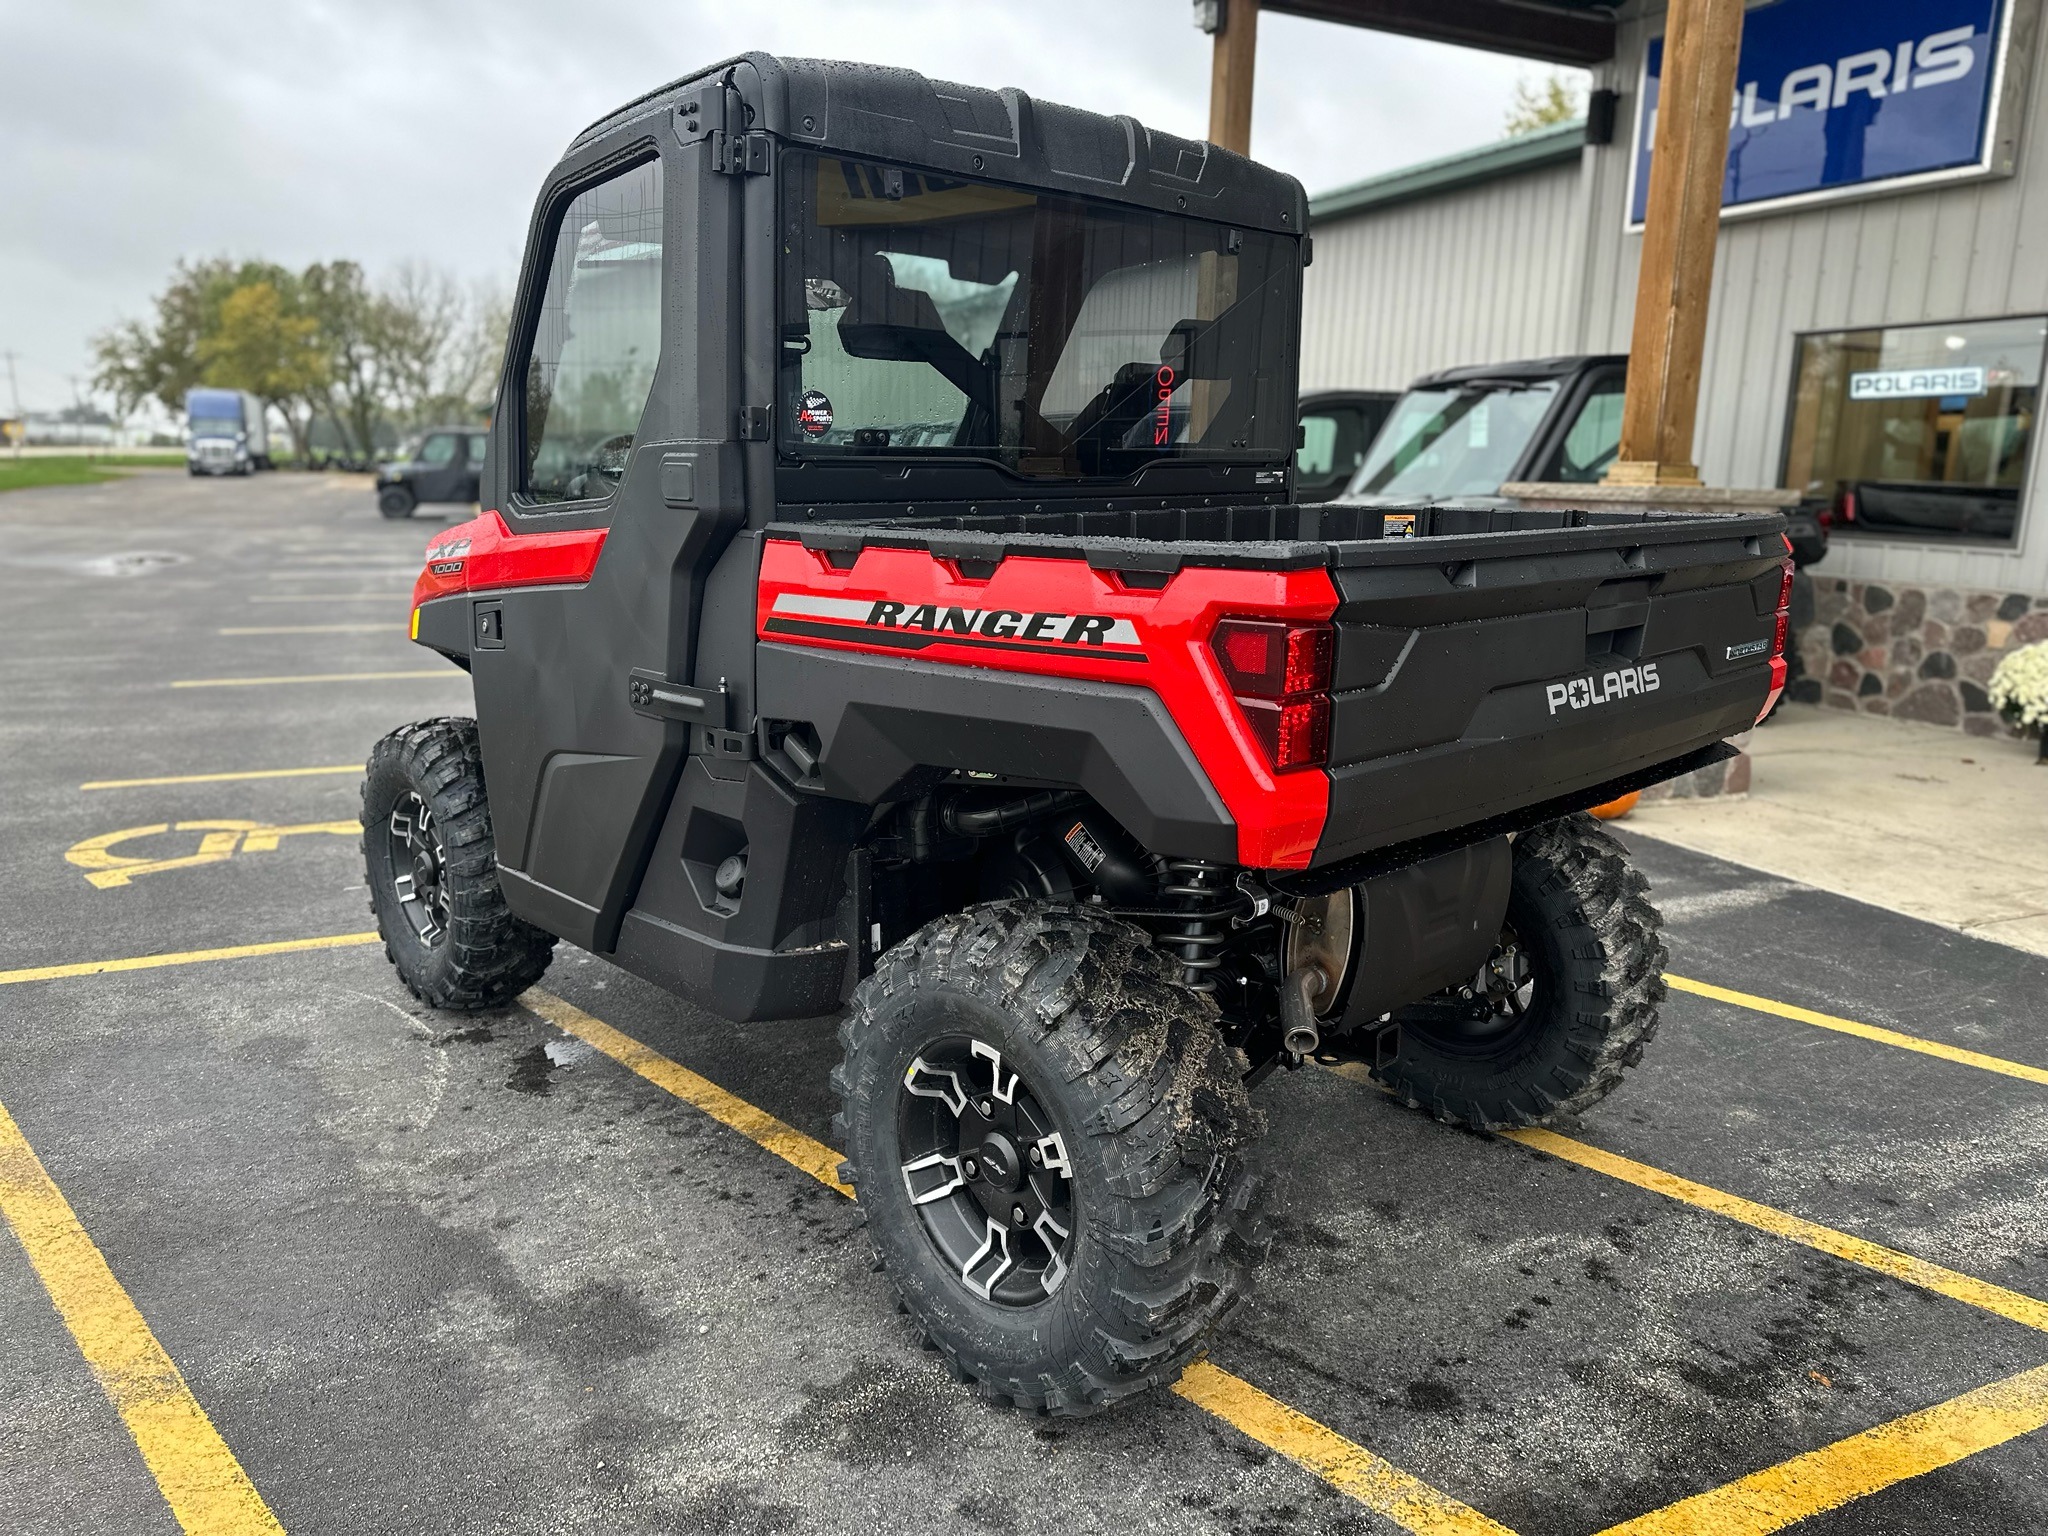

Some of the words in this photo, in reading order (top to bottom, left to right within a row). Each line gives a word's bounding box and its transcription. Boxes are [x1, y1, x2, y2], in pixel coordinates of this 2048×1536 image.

[1646, 25, 1976, 151] LARIS
[1855, 372, 1979, 393] POLARIS
[430, 538, 472, 560] XP
[434, 562, 463, 573] 1000
[865, 600, 1116, 646] RANGER
[1546, 663, 1660, 715] POLARIS
